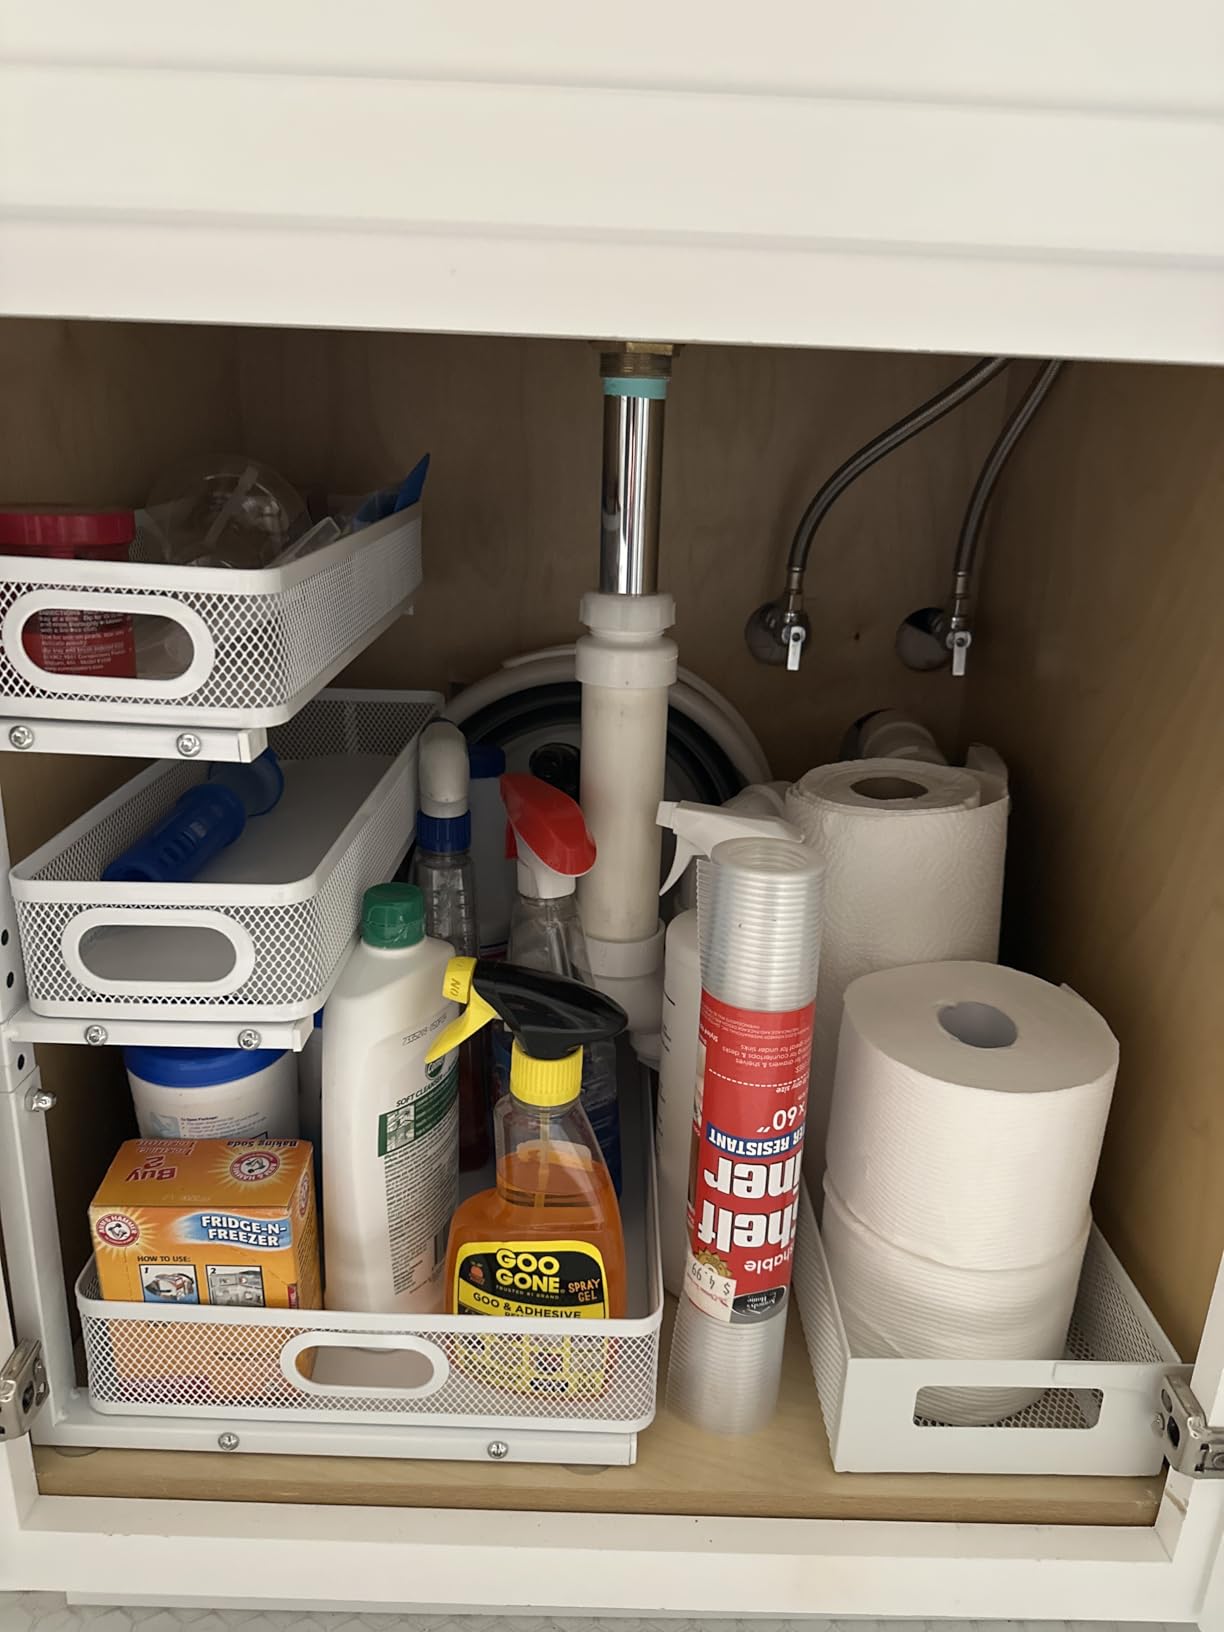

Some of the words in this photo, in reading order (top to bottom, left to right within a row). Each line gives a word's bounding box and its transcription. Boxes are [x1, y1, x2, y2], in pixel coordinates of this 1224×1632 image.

[740, 1044, 757, 1053] sinks
[735, 1058, 761, 1068] shelves
[748, 1052, 788, 1061] countertops
[768, 1059, 794, 1068] drawers
[775, 1084, 790, 1094] size
[396, 1092, 416, 1107] SOFT
[226, 1140, 255, 1148] Soda
[257, 1139, 298, 1148] Baking
[708, 1128, 790, 1156] RESISTANT
[143, 1155, 166, 1168] 2
[124, 1167, 177, 1183] Buy
[704, 1151, 802, 1199] iner
[201, 1215, 287, 1236] FRIDGE-N-
[208, 1227, 281, 1248] FREEZER
[137, 1255, 159, 1263] HOW
[160, 1255, 171, 1263] TO
[171, 1255, 191, 1263] USE:
[496, 1249, 560, 1274] GOO
[143, 1266, 149, 1275] 1
[210, 1267, 217, 1275] 2
[691, 1262, 716, 1289] 4.99
[496, 1268, 560, 1294] GONE
[568, 1278, 601, 1293] SPRAY
[495, 1284, 525, 1296] TRUSTED
[577, 1290, 598, 1303] GEL
[473, 1292, 500, 1308] GOO
[503, 1302, 512, 1311] &
[515, 1305, 582, 1318] ADHESIVE
